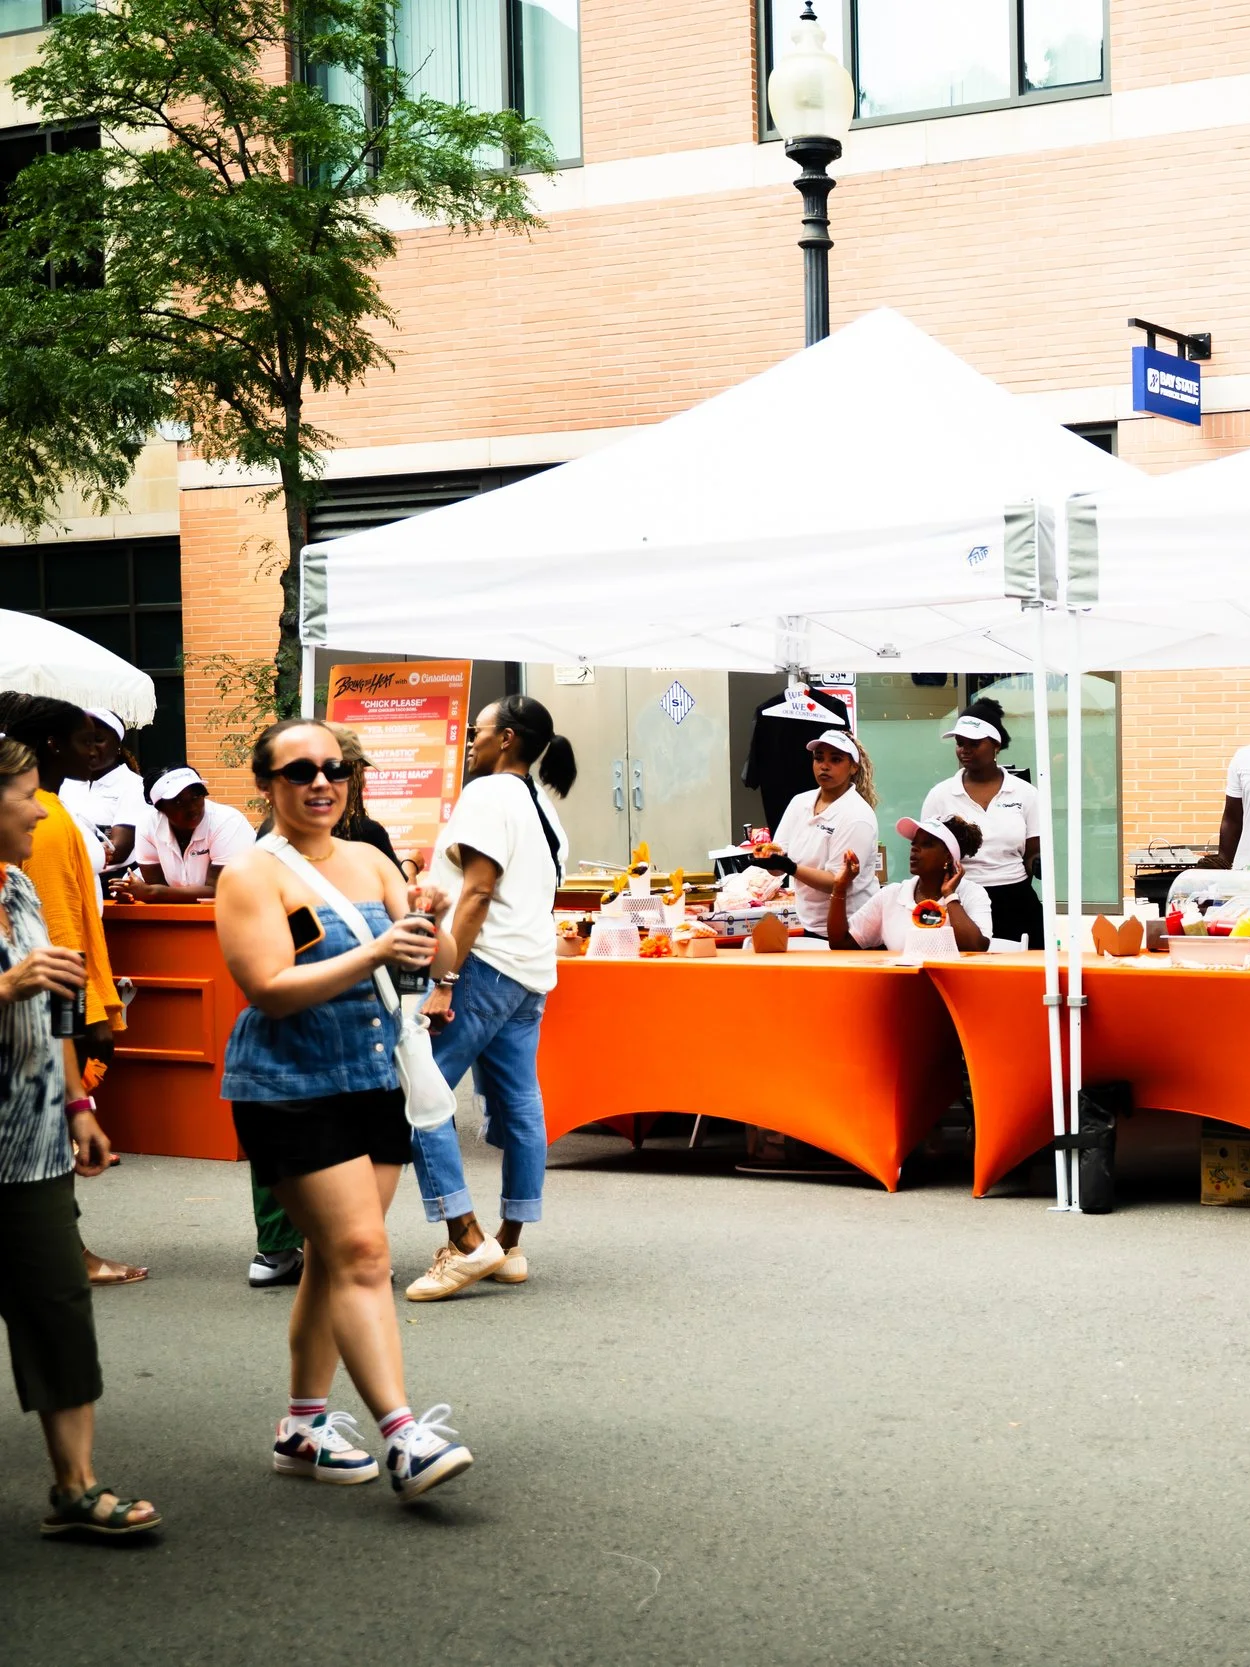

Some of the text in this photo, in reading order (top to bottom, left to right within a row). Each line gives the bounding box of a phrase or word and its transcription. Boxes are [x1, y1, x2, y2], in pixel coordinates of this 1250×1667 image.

[1160, 371, 1176, 388] BAY
[1175, 376, 1199, 396] STATE
[421, 672, 464, 683] Cinsational
[791, 702, 806, 711] WE
[450, 725, 458, 740] $20
